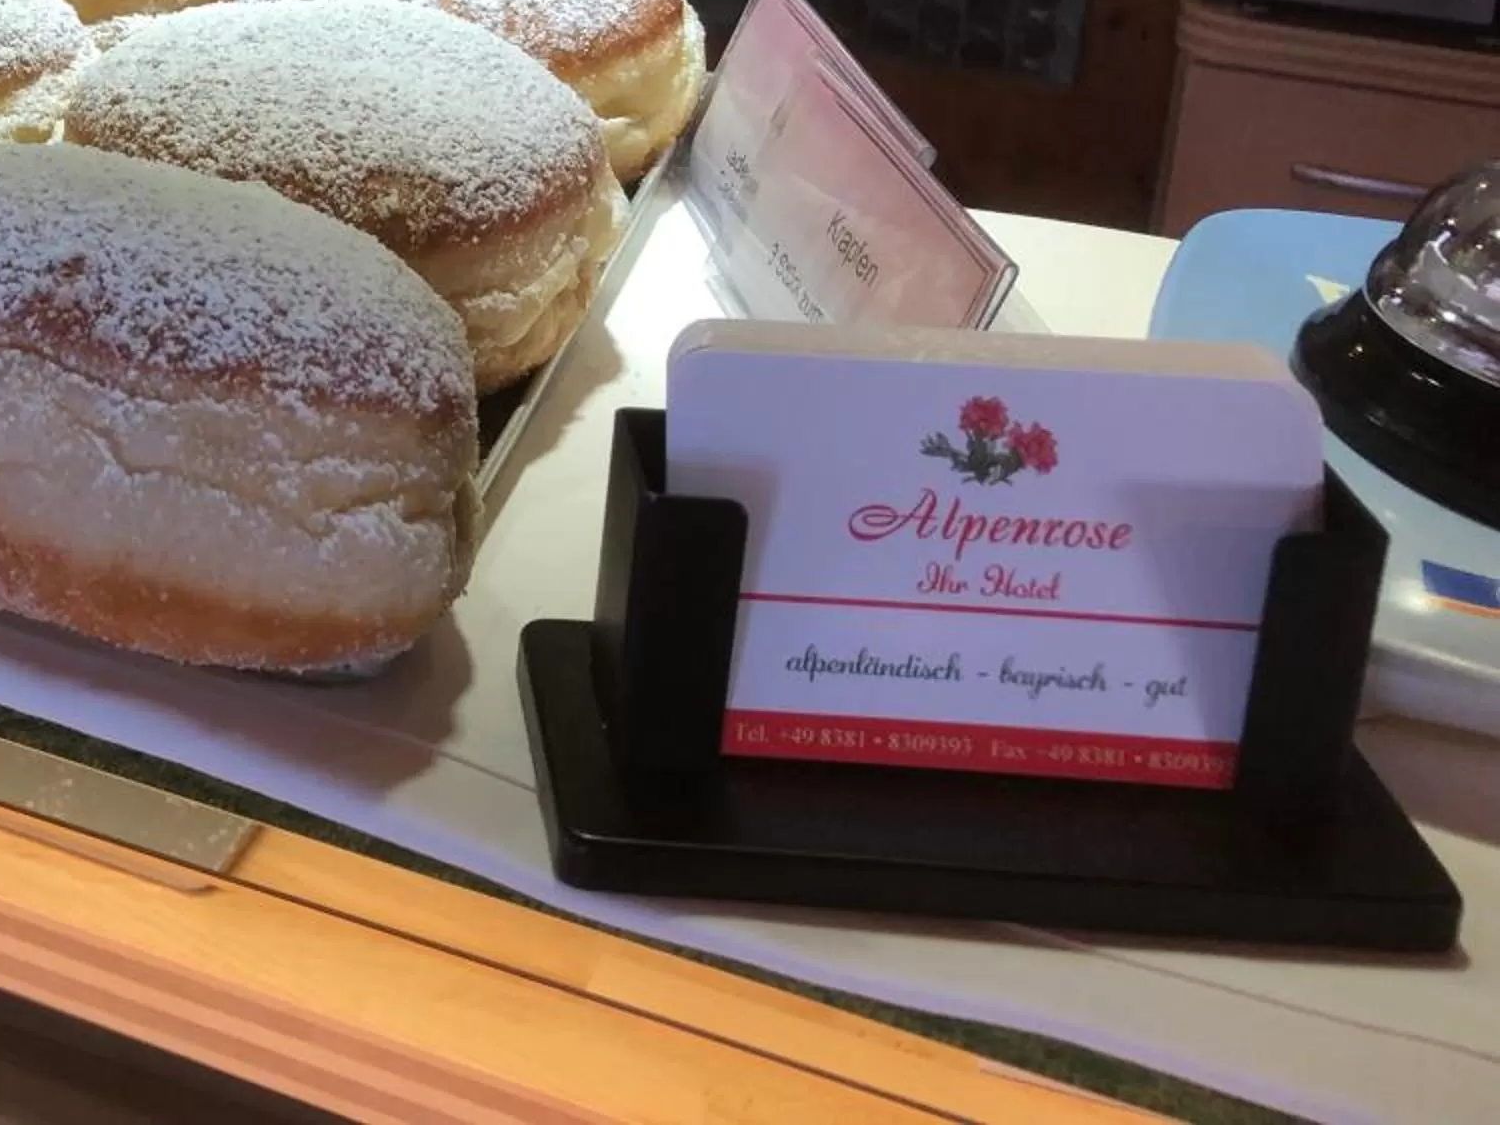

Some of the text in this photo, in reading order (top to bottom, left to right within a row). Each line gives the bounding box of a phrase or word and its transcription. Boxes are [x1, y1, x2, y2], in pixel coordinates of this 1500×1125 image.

[826, 208, 879, 288] Krapfen
[848, 487, 1134, 561] Alpenrose
[917, 561, 1061, 600] Ihr Hotel
[785, 642, 961, 683] alpenländisch
[999, 655, 1107, 700] bayrisch
[1144, 676, 1189, 707] gut
[735, 723, 769, 744] Tel.
